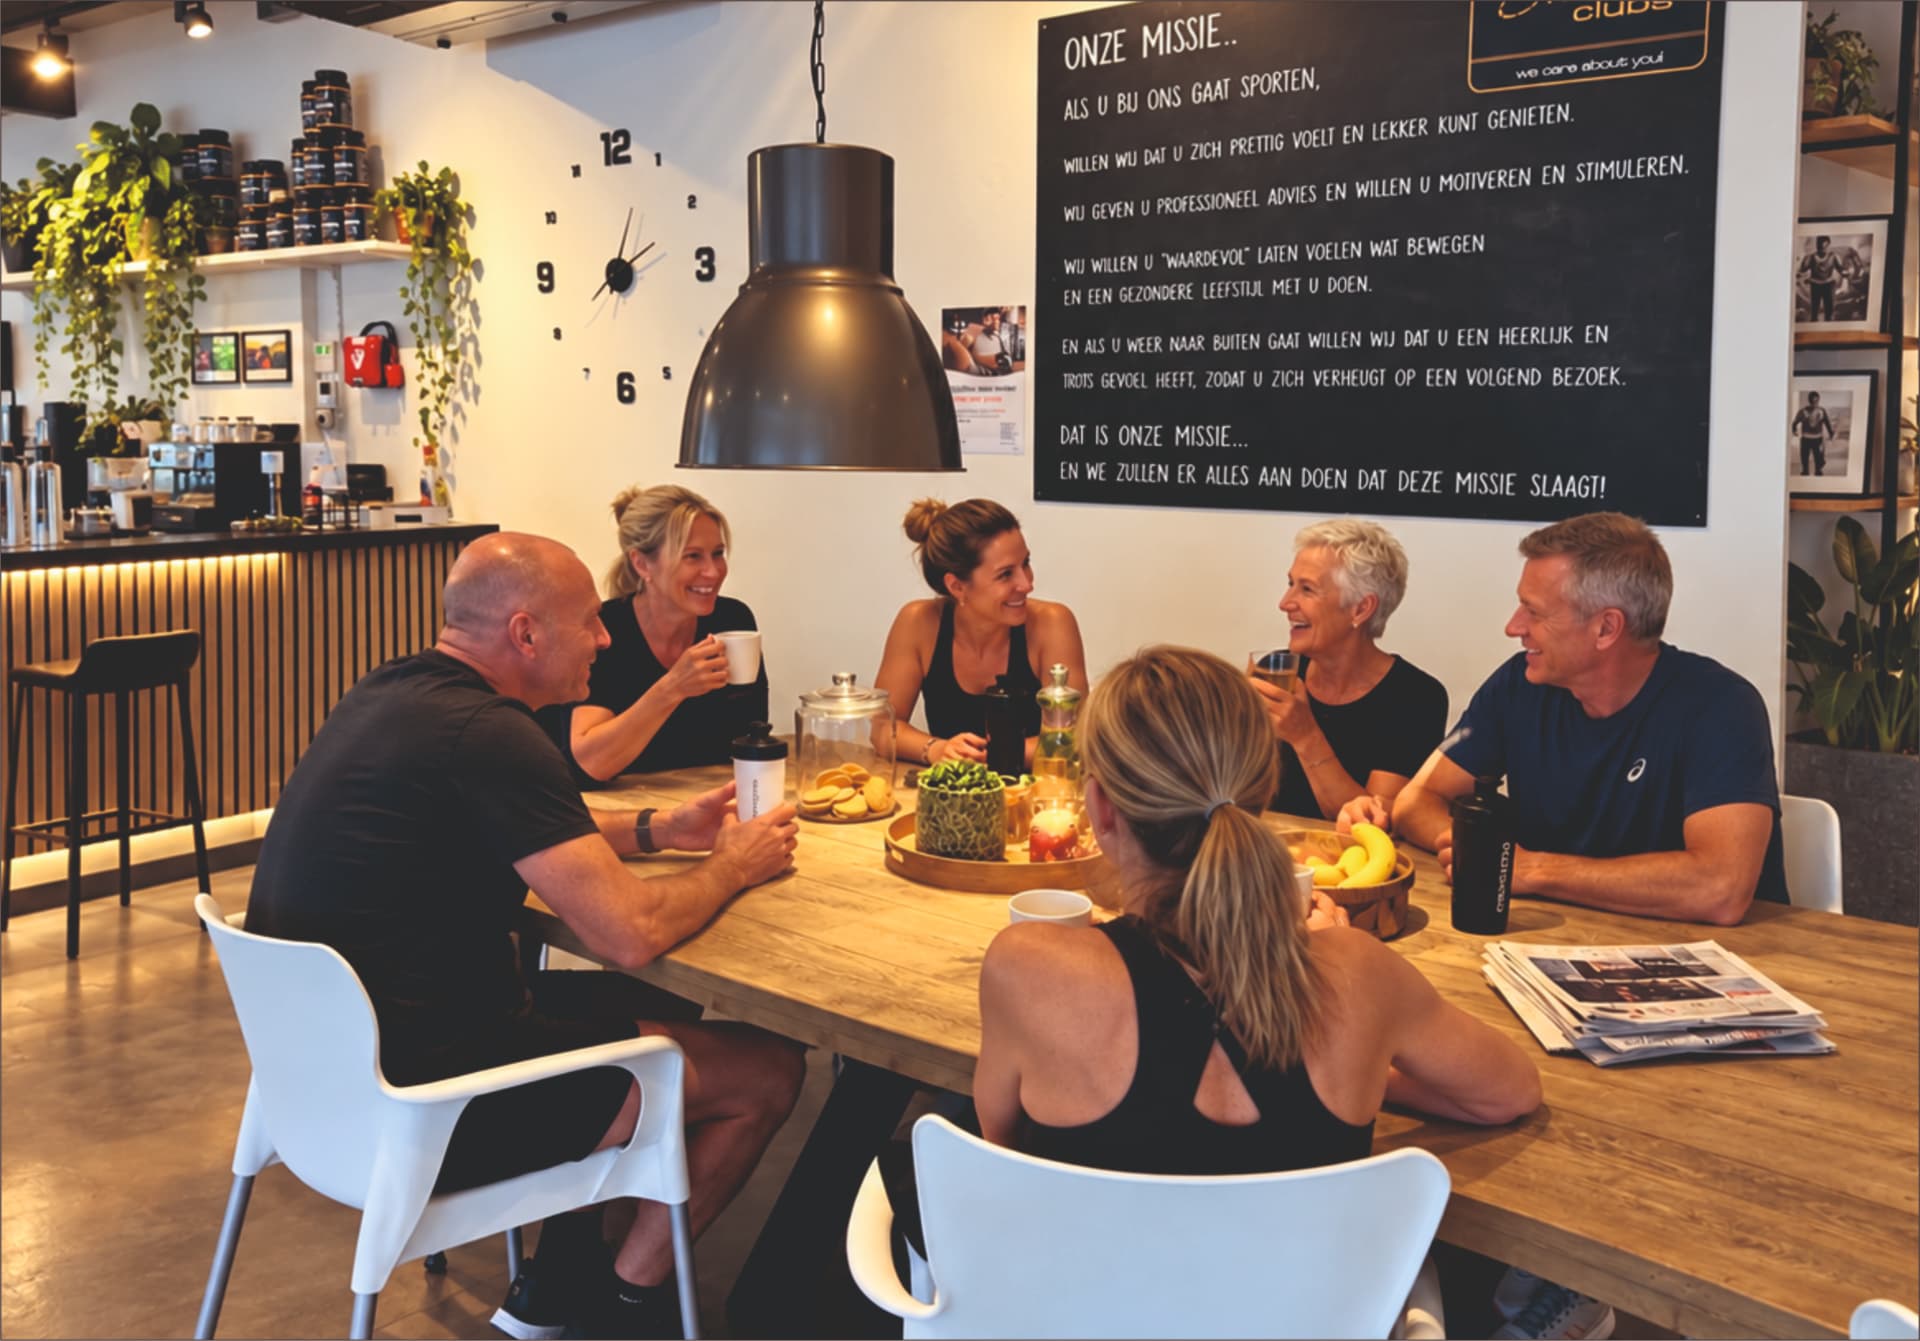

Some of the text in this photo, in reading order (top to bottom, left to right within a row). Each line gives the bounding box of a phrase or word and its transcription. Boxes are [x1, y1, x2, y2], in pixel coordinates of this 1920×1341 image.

[1572, 1, 1673, 22] clubs
[1064, 13, 1238, 71] ONZE MISSIE..
[1516, 69, 1538, 79] we
[1542, 64, 1577, 76] care
[1582, 59, 1628, 72] about
[1063, 66, 1321, 121] ALS U BIJ ONS GAAT SPORTEN,
[600, 129, 632, 167] 12
[1063, 102, 1575, 175] WILLEN WIJ DAT U ZICH PRETTIG VOELT EN LEKKER KUNT GENIETEN.
[655, 152, 662, 167] 1
[687, 194, 697, 209] 2
[1063, 153, 1689, 222] WIJ GEVEN U PROFESSIONEEL ADVIES EN WILLEN U MOTIVEREN EN STIMULEREN.
[695, 246, 716, 282] 3
[1063, 258, 1086, 275] WIJ
[1090, 255, 1138, 274] WILLEN
[1144, 253, 1154, 271] U
[1257, 243, 1299, 265] LATEN
[1305, 240, 1363, 262] VOELEN
[1369, 237, 1400, 258] WAT
[1406, 233, 1485, 257] BEWEGEN
[536, 261, 555, 294] 9
[1063, 274, 1373, 307] EN EEN GEZONDERE LEEFSTIJL MET U DOEN.
[553, 327, 562, 340] 8
[1061, 324, 1609, 355] EN ALS U WEER NAAR BUITEN GAAT WILLEN WIJ DAT U EEN HEERLIJK EN
[616, 371, 636, 404] 6
[662, 366, 672, 380] 5
[1063, 365, 1627, 390] TROTS GEVOEL HEEFT, ZODAT U ZICH VERHEUGT OP EEN VOLGEND BEZOEK.
[1060, 424, 1249, 448] DAT IS ONZE MISSIE...
[1059, 460, 1607, 500] EN WE ZULLEN ER ALLES AAN DOEN DAT DEZE MISSIE SLAAGT!
